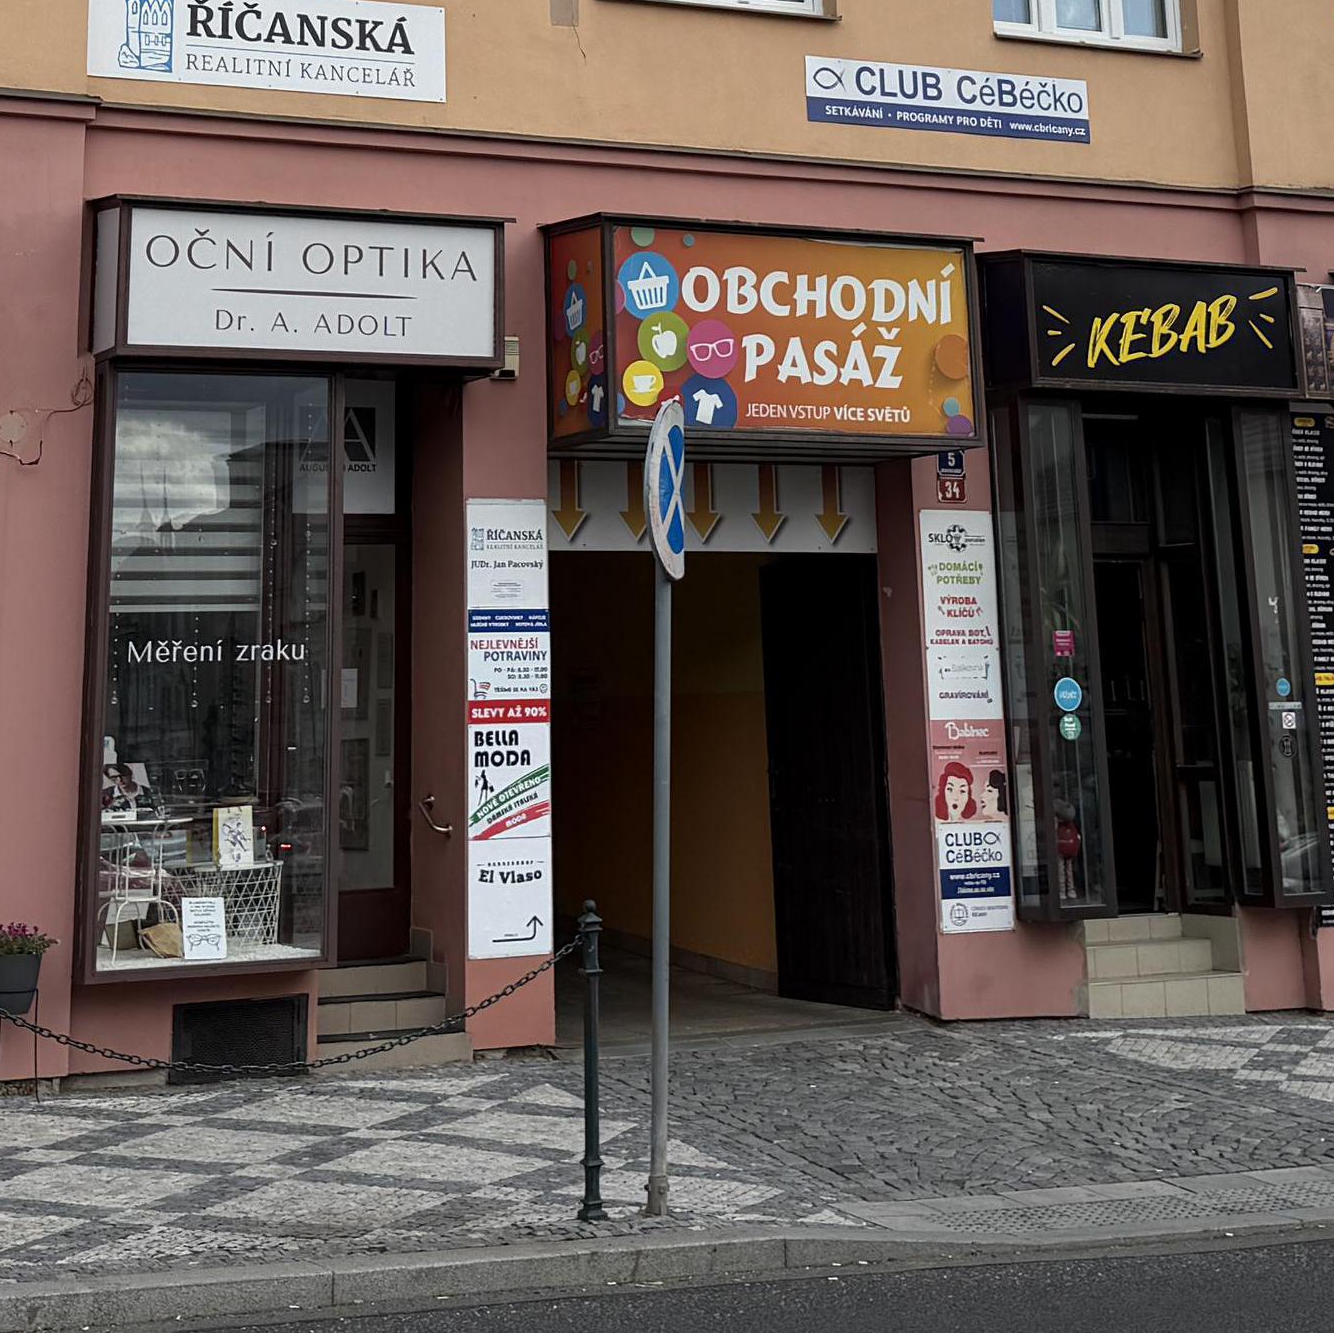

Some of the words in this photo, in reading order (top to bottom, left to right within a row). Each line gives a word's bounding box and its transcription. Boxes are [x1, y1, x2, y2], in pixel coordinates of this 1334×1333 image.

[186, 53, 291, 78] REALITNÍ
[300, 62, 416, 88] KANCELÁŘ
[855, 66, 943, 101] CLUB
[956, 75, 1083, 114] CéBéčko
[825, 105, 883, 119] SETKÁVÁNÍ
[896, 111, 954, 125] PROGRAMY
[956, 116, 978, 127] PRO
[980, 116, 1003, 129] DĚTI
[145, 229, 274, 273] OČNÍ
[302, 241, 477, 283] OPTIKA
[681, 262, 954, 324] OBCHODNÍ
[214, 309, 256, 334] Dr.
[271, 311, 299, 335] A.
[313, 313, 413, 338] ADOLT
[1086, 295, 1238, 368] KEBAB
[742, 321, 904, 389] PASÁŽ
[746, 403, 785, 418] JEDEN
[789, 404, 830, 419] VSTUP
[834, 403, 864, 420] VÍCE
[867, 404, 910, 423] SVĚTŮ
[947, 452, 956, 467] 5
[348, 464, 376, 472] ADOLT
[945, 481, 960, 499] 34
[487, 528, 543, 541] ŘÍČANSKÁ
[928, 533, 954, 543] SKLO
[471, 560, 492, 569] JUDr.
[494, 561, 507, 569] Jan
[508, 559, 544, 569] Pacovský
[939, 560, 977, 571] DOMÁCÍ
[937, 573, 981, 585] POTŘEBY
[940, 594, 977, 605] VÝROBA
[947, 606, 974, 617] KLÍČŮ
[128, 640, 223, 663] Měření
[236, 639, 305, 661] zraku
[470, 637, 538, 650] NEJLEVNĚJŠÍ
[484, 650, 547, 661] POTRAVINY
[471, 708, 505, 718] SLEVY
[507, 704, 523, 717] AŽ
[524, 706, 547, 717] 90%
[474, 730, 519, 747] BELLA
[474, 749, 531, 767] MODA
[945, 832, 983, 847] CLUB
[946, 848, 1003, 863] CéBéčko
[478, 869, 494, 884] El
[499, 870, 542, 884] Vlaso
